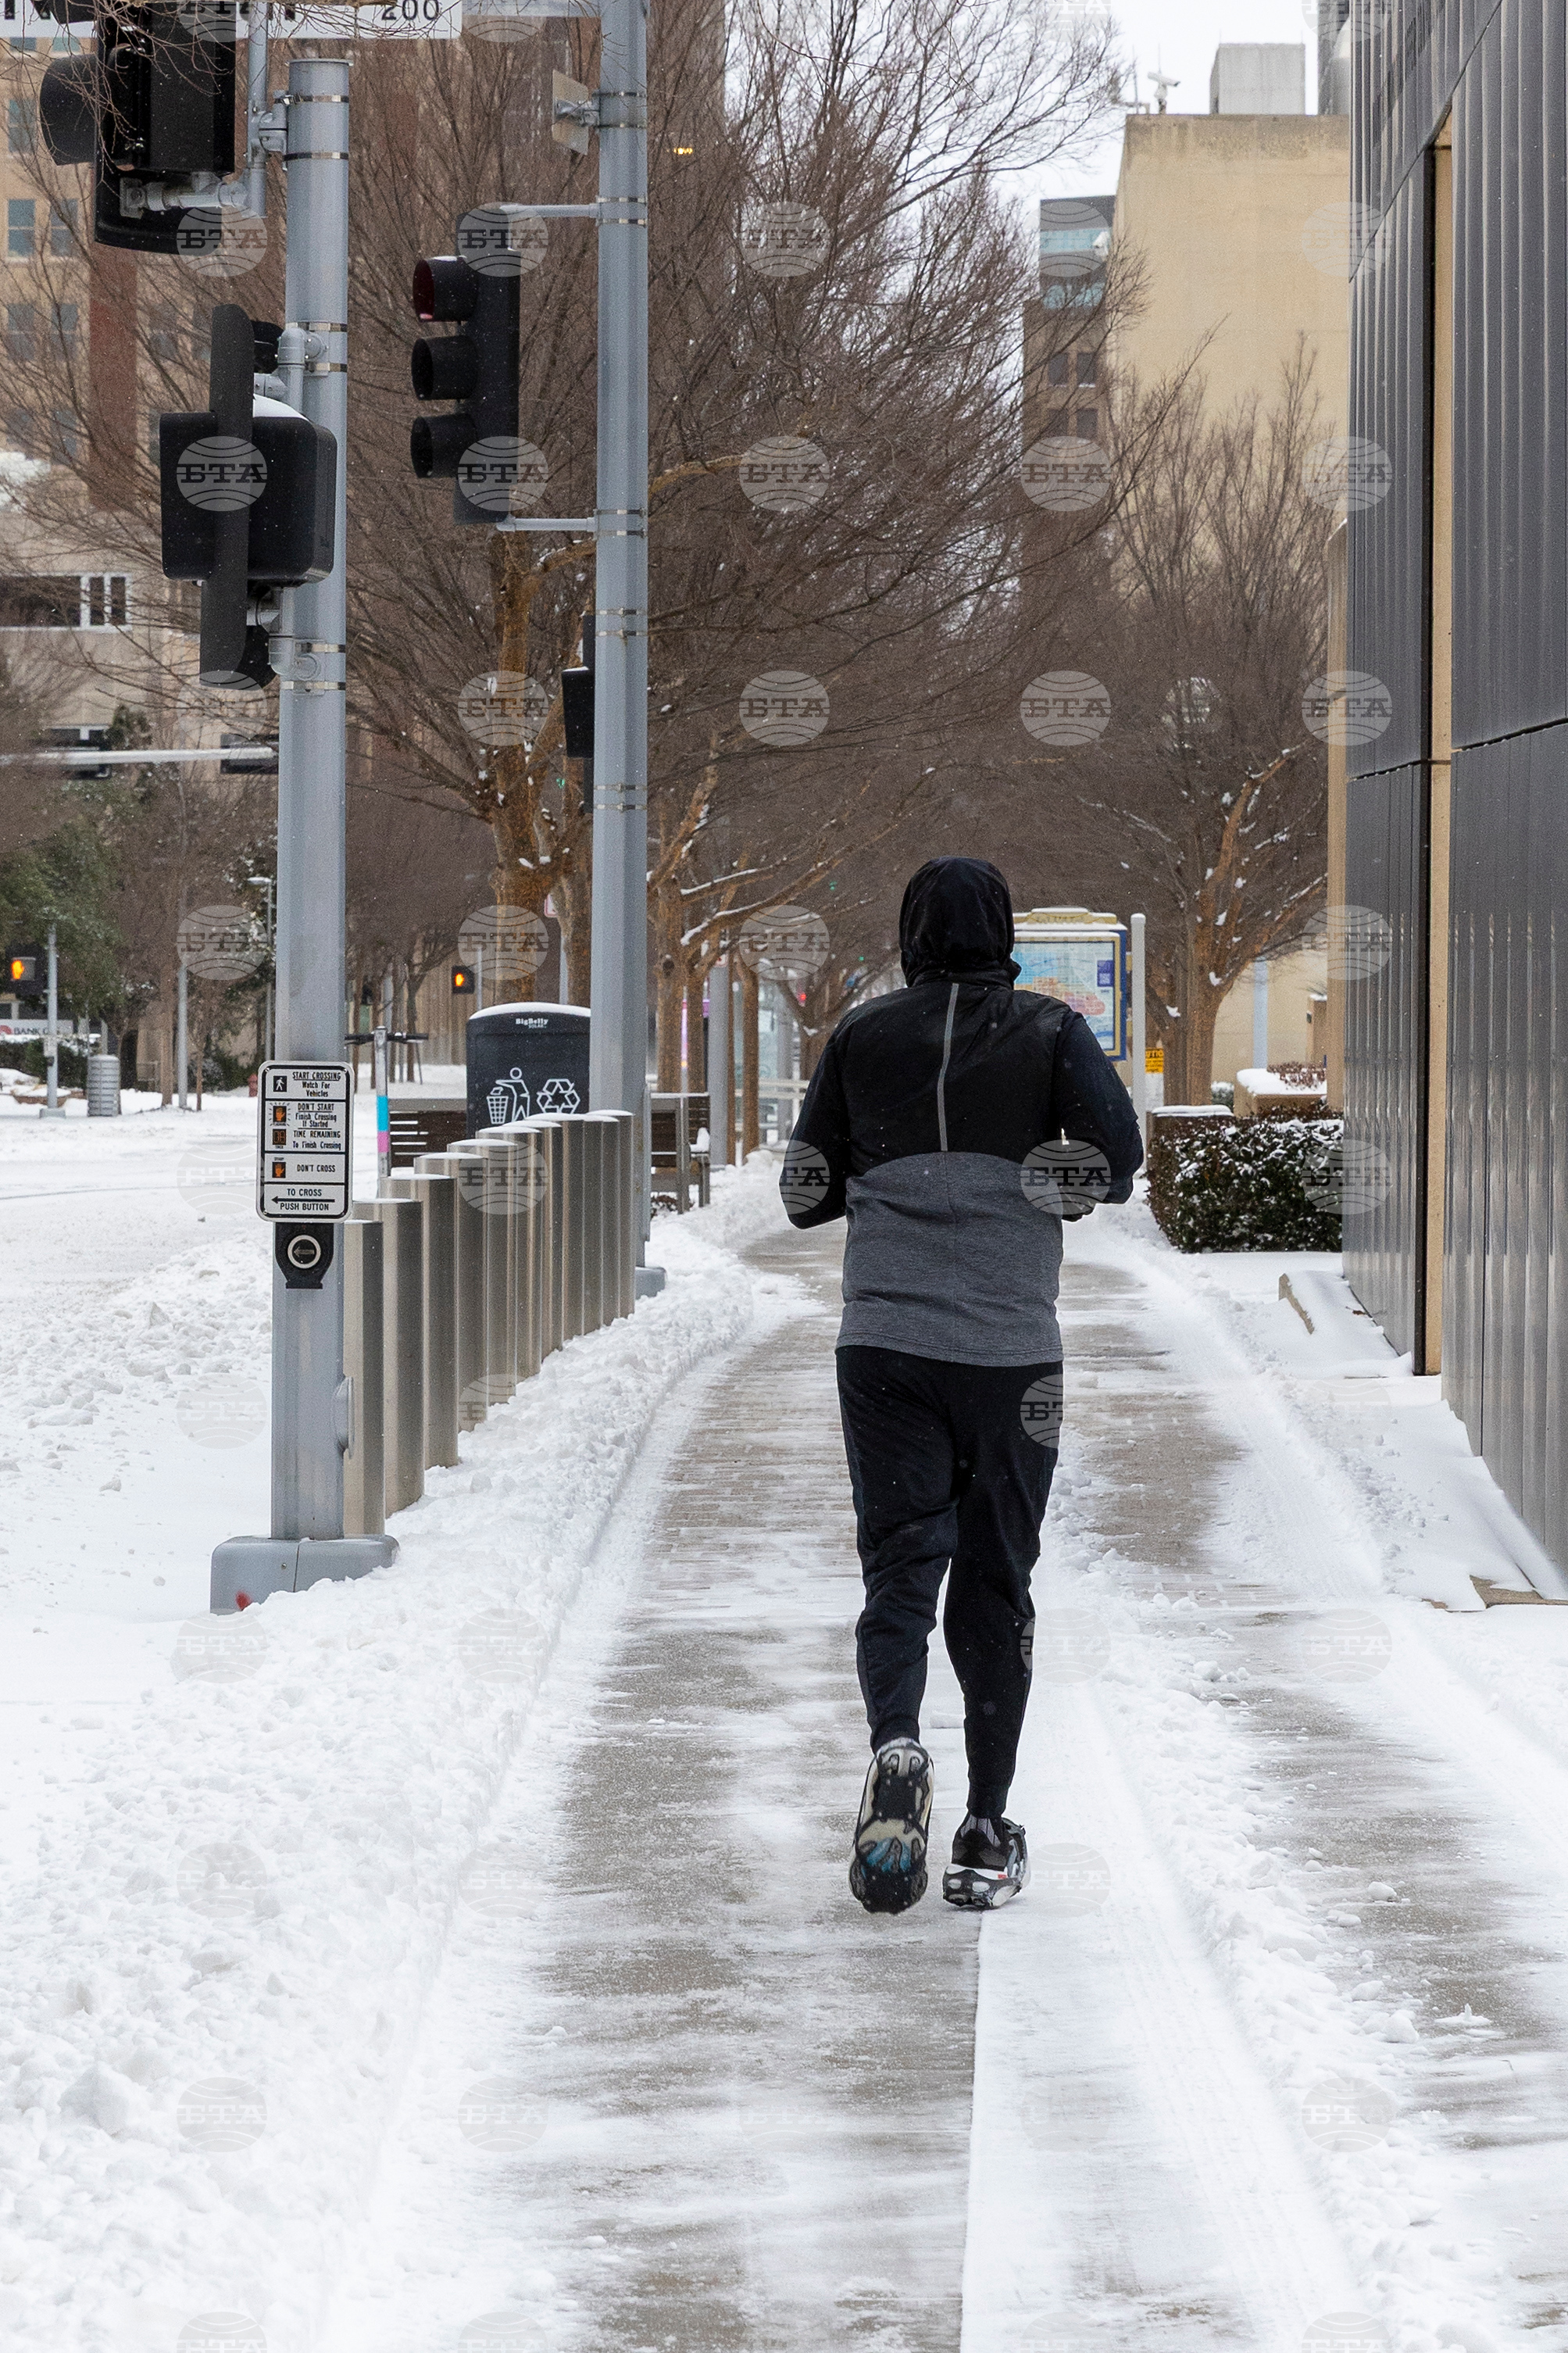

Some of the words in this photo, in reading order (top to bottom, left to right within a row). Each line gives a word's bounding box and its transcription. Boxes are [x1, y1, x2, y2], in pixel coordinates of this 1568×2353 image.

[380, 0, 439, 20] 200
[314, 1113, 337, 1122] Crossing
[320, 1141, 341, 1150] Crossing
